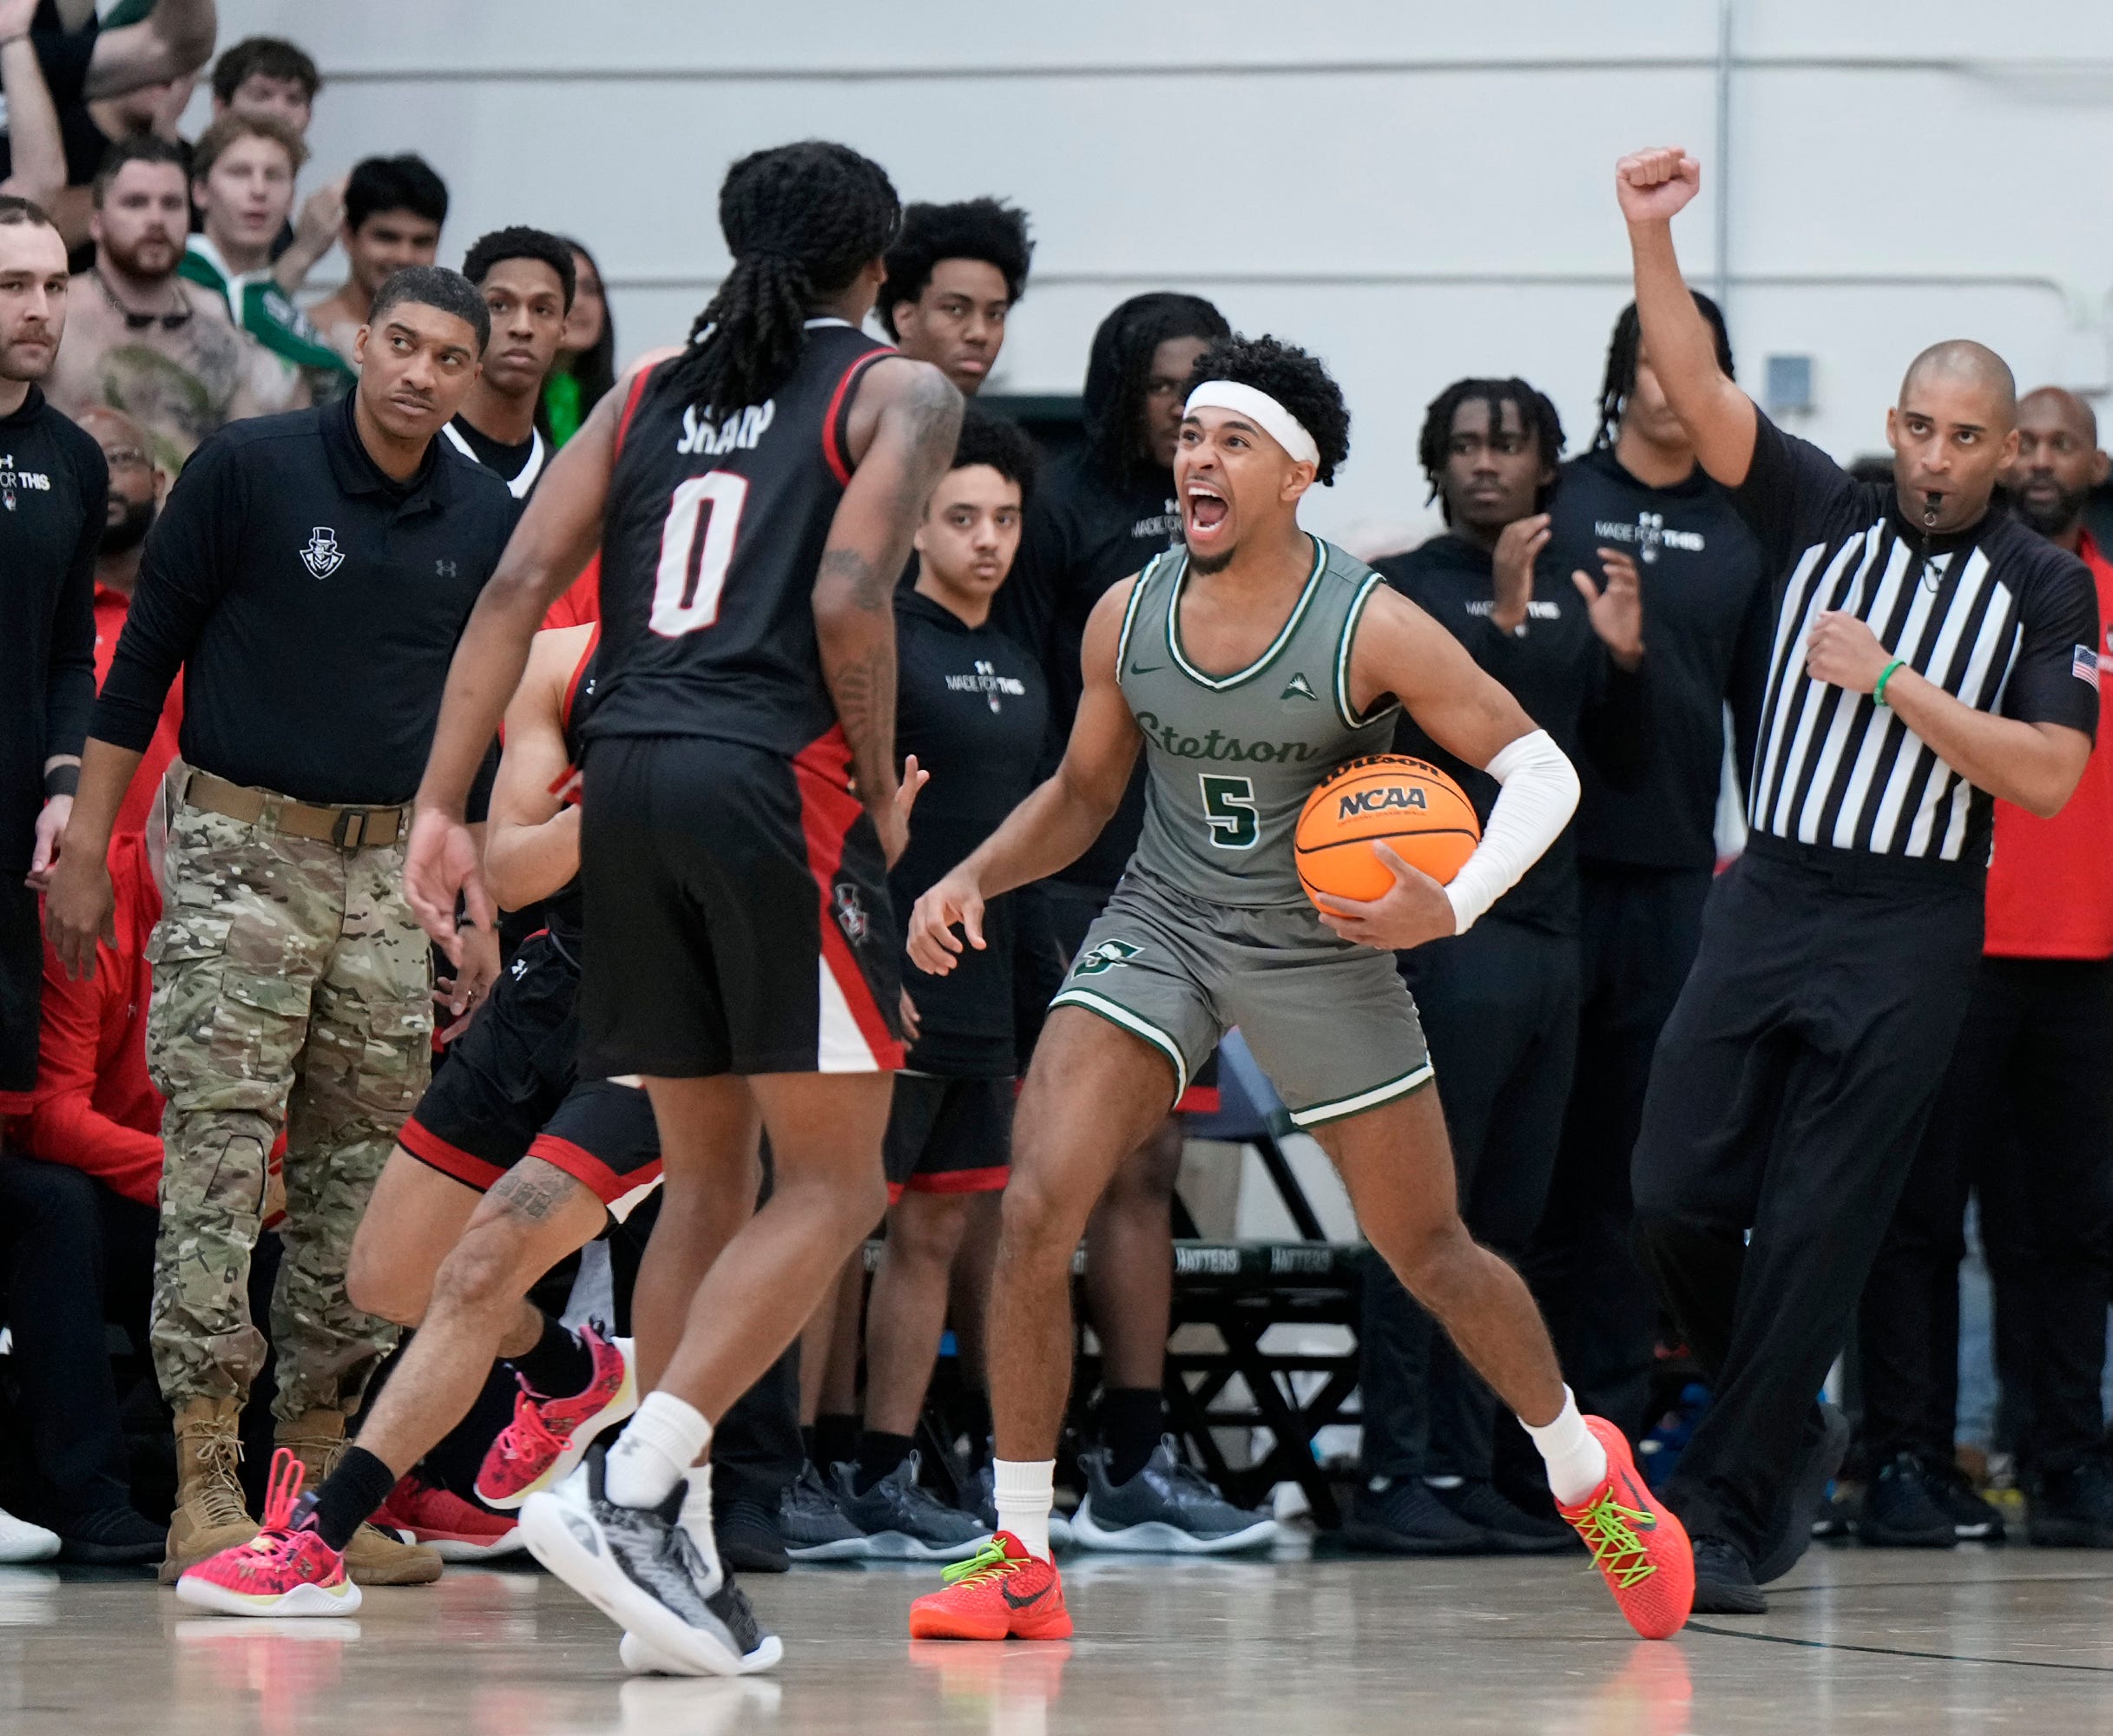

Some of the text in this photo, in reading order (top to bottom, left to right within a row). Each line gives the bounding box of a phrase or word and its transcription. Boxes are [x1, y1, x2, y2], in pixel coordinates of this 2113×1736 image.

[18, 471, 50, 491] THIS
[1596, 520, 1633, 542] MADE
[1662, 529, 1705, 551] THIS
[648, 469, 749, 639] 0
[1526, 600, 1561, 619] THIS
[1135, 711, 1320, 763] Stetson
[1198, 773, 1261, 850] 5
[1338, 786, 1428, 820] NCAA
[1175, 1247, 1239, 1273] HATTERS
